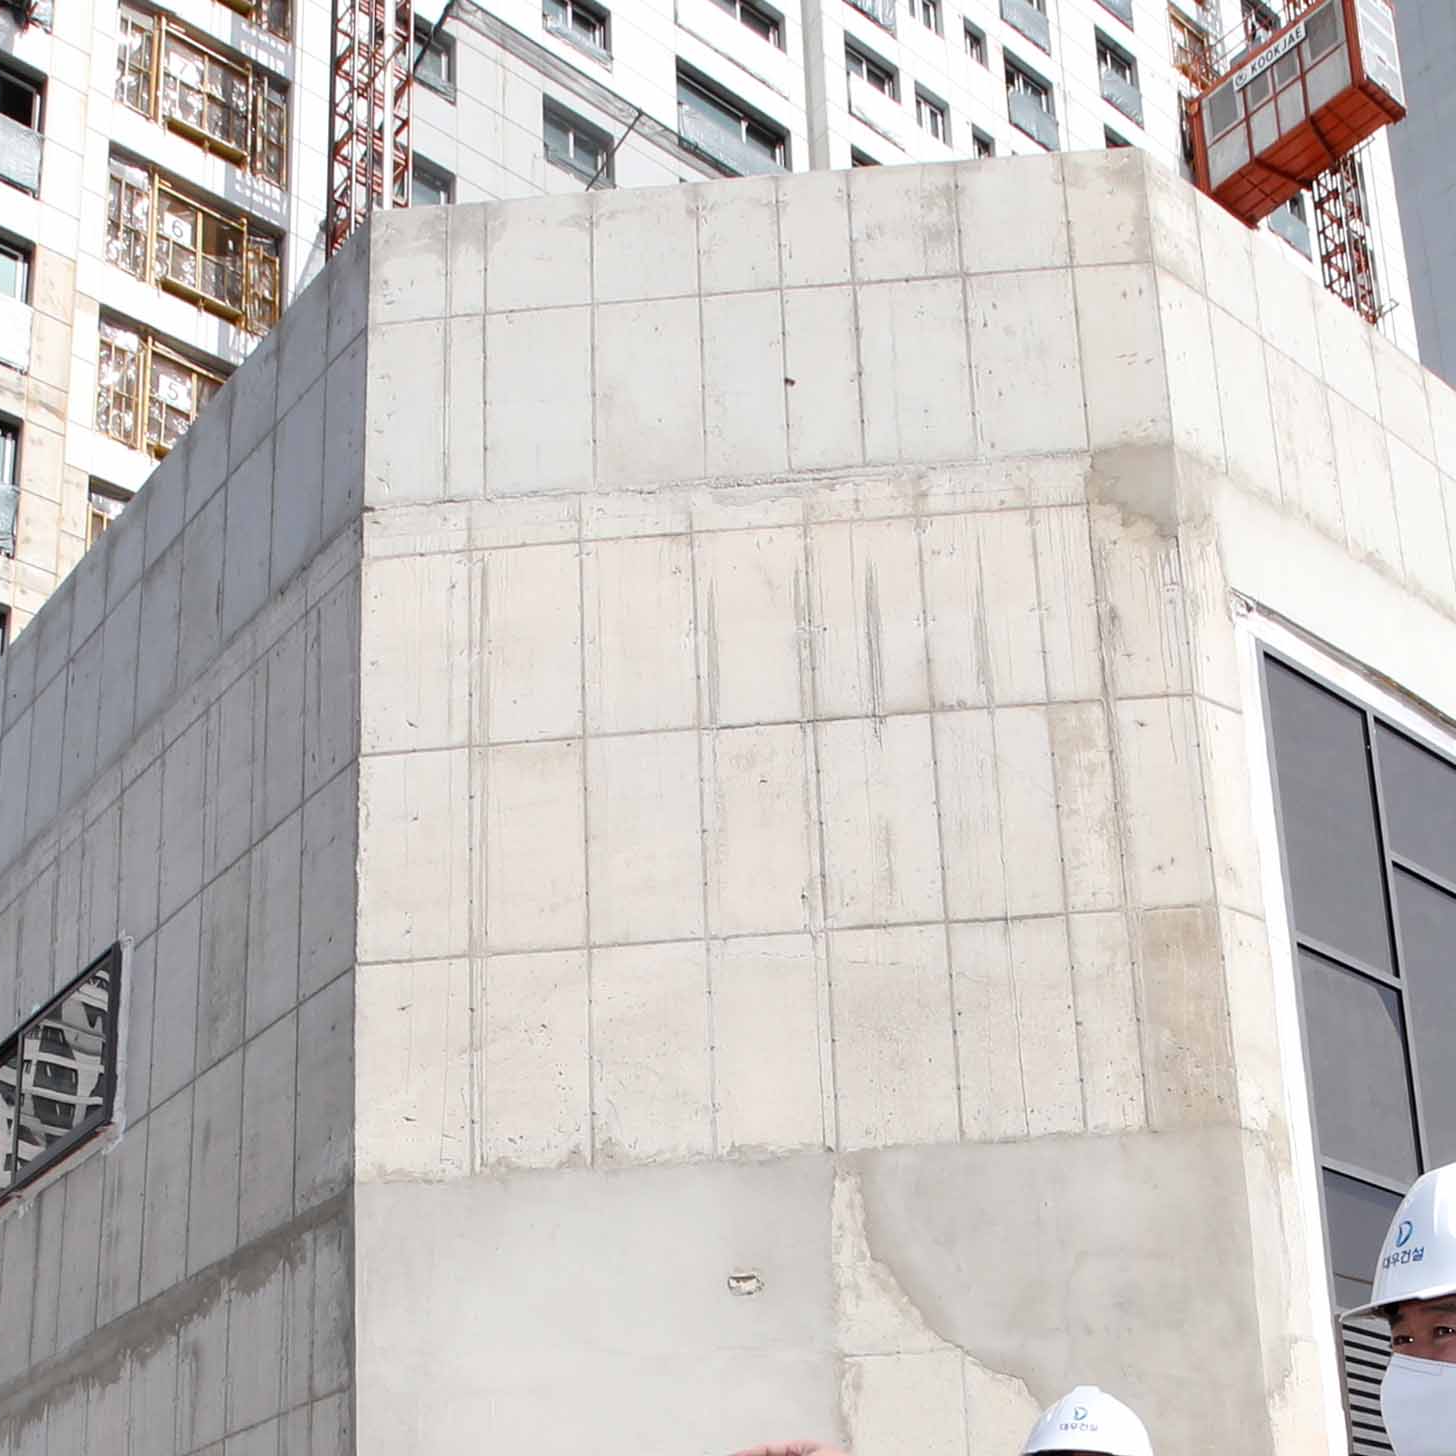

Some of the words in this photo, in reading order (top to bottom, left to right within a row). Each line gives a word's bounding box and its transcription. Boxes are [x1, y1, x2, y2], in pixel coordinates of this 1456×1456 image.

[1250, 26, 1302, 74] KOOKJAE
[171, 218, 184, 239] 6
[167, 384, 179, 401] 5
